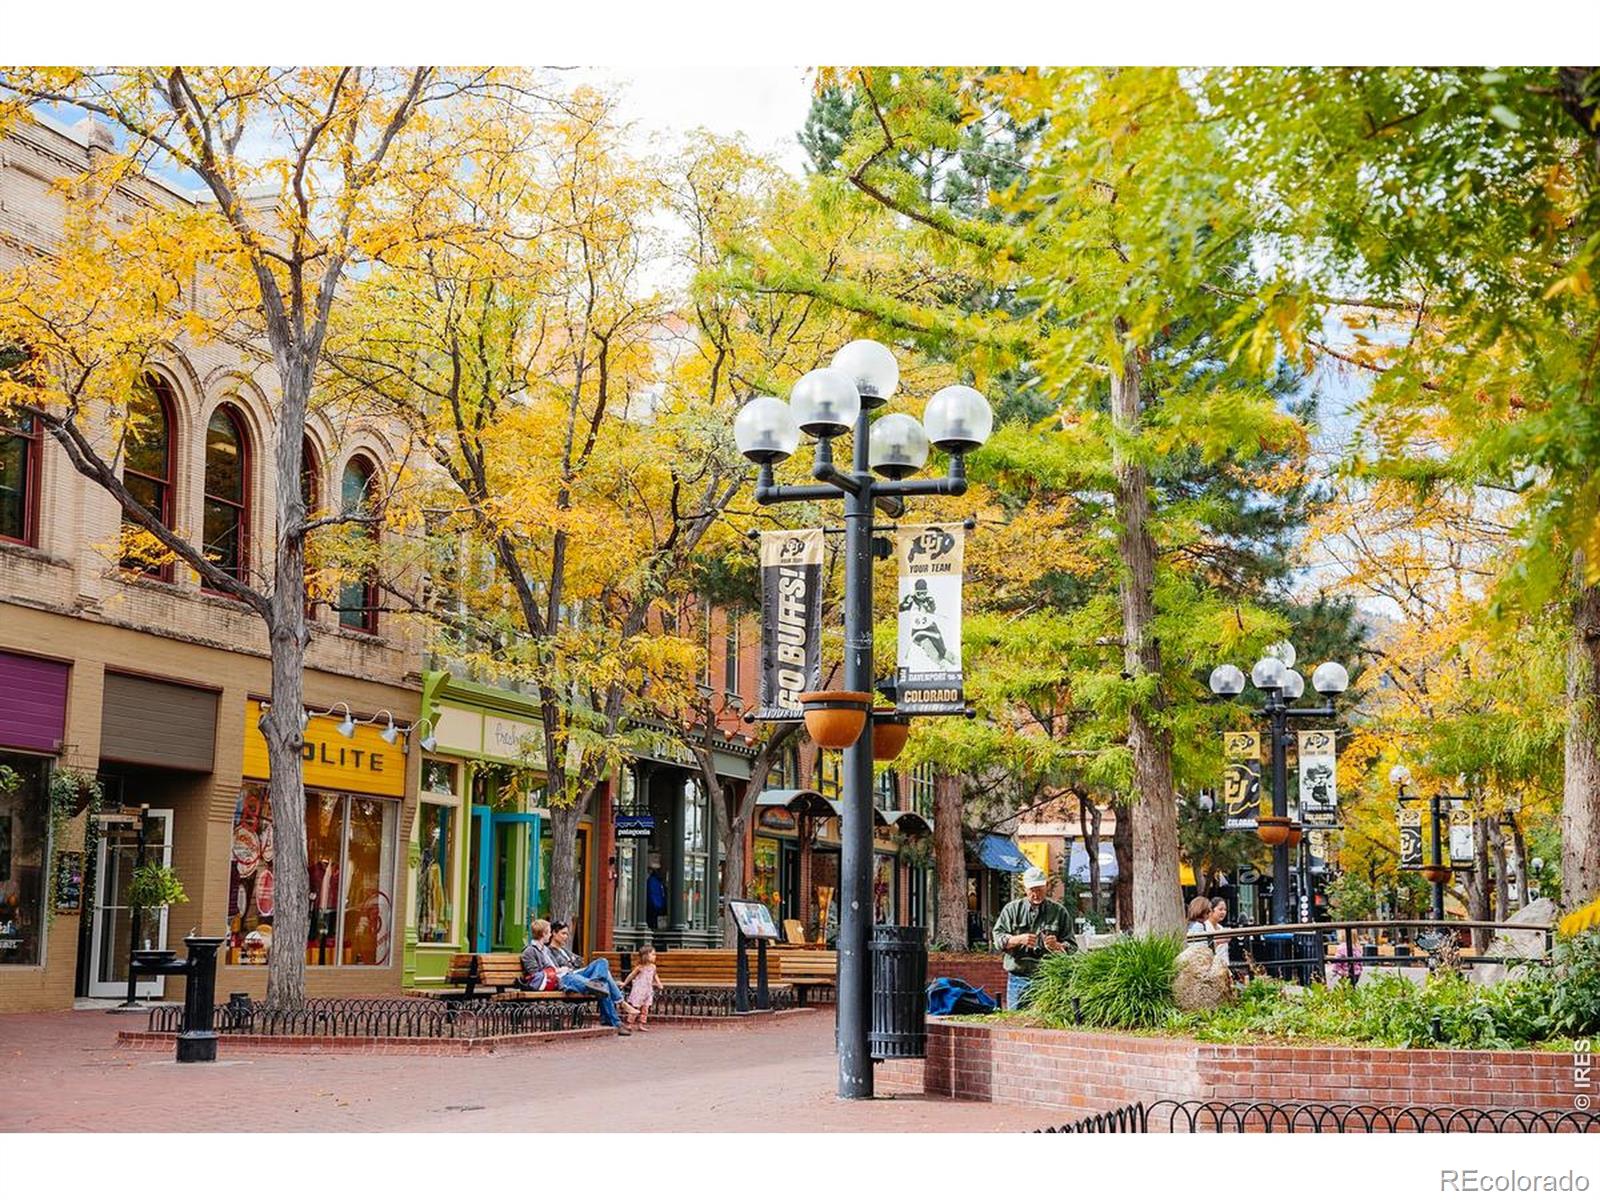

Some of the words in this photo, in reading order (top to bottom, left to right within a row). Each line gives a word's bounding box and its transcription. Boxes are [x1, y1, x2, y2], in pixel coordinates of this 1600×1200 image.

[909, 564, 929, 574] YOUR
[931, 563, 952, 573] TEAM
[778, 567, 807, 667] BUFFS!
[778, 669, 806, 710] GO
[904, 689, 958, 703] COLORADO
